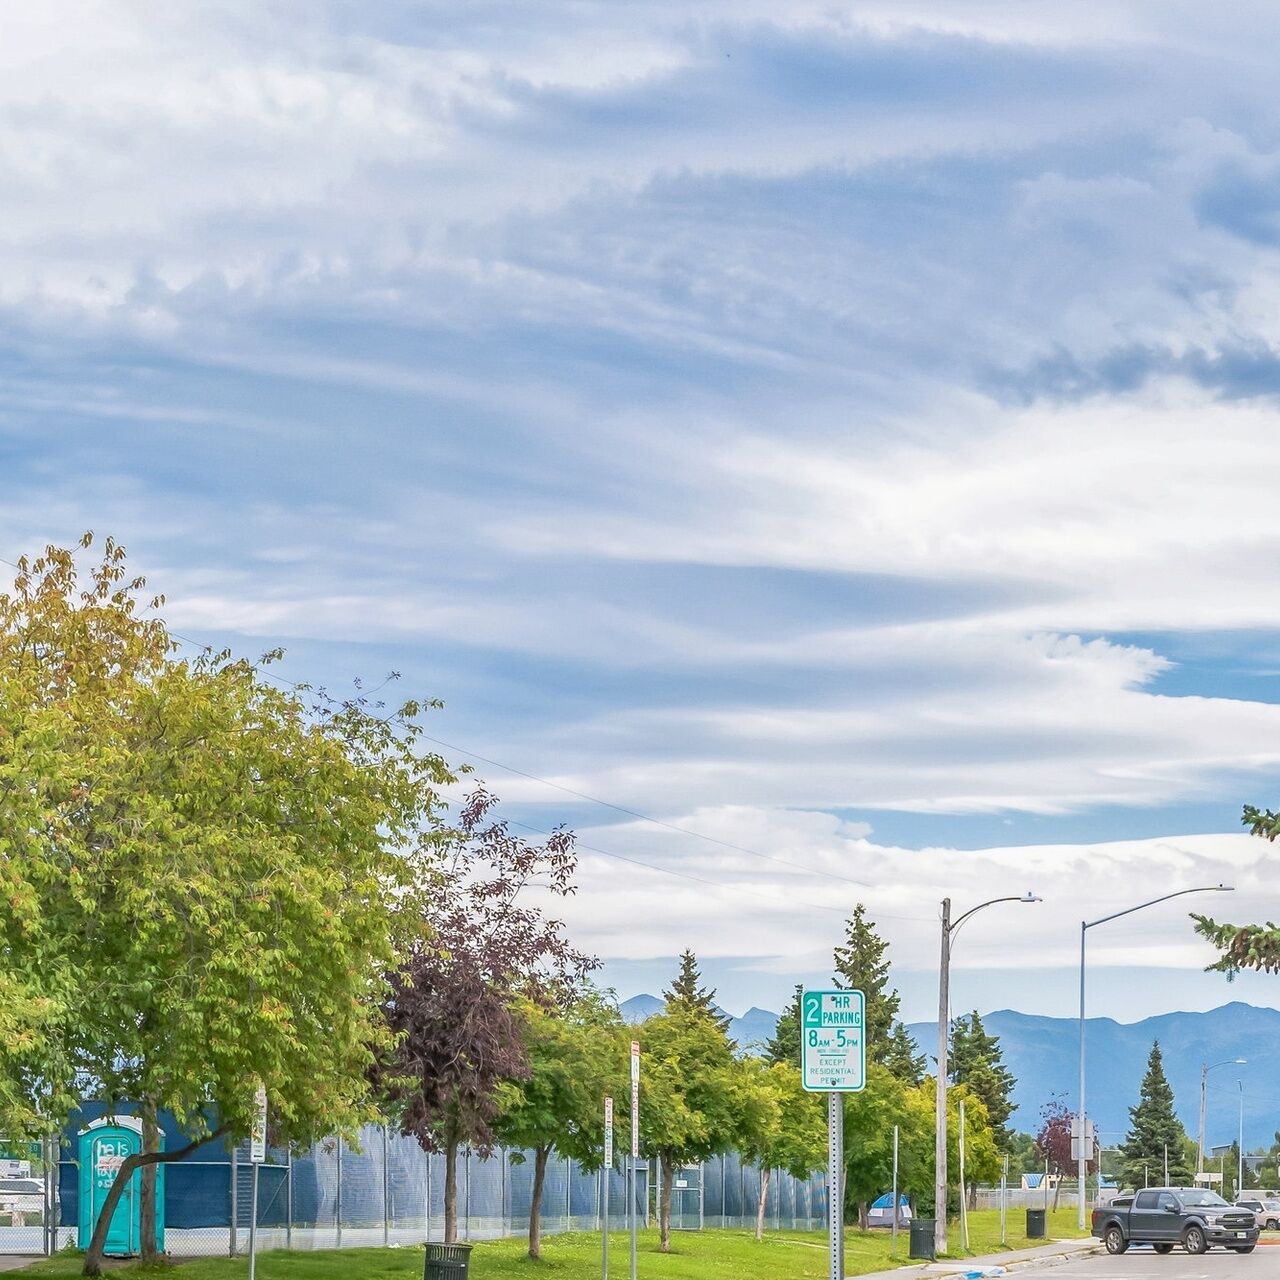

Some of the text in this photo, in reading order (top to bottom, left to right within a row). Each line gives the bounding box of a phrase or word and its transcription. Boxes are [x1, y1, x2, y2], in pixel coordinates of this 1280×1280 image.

[835, 996, 850, 1008] HR
[806, 998, 819, 1022] 2
[823, 1012, 860, 1024] PARKING
